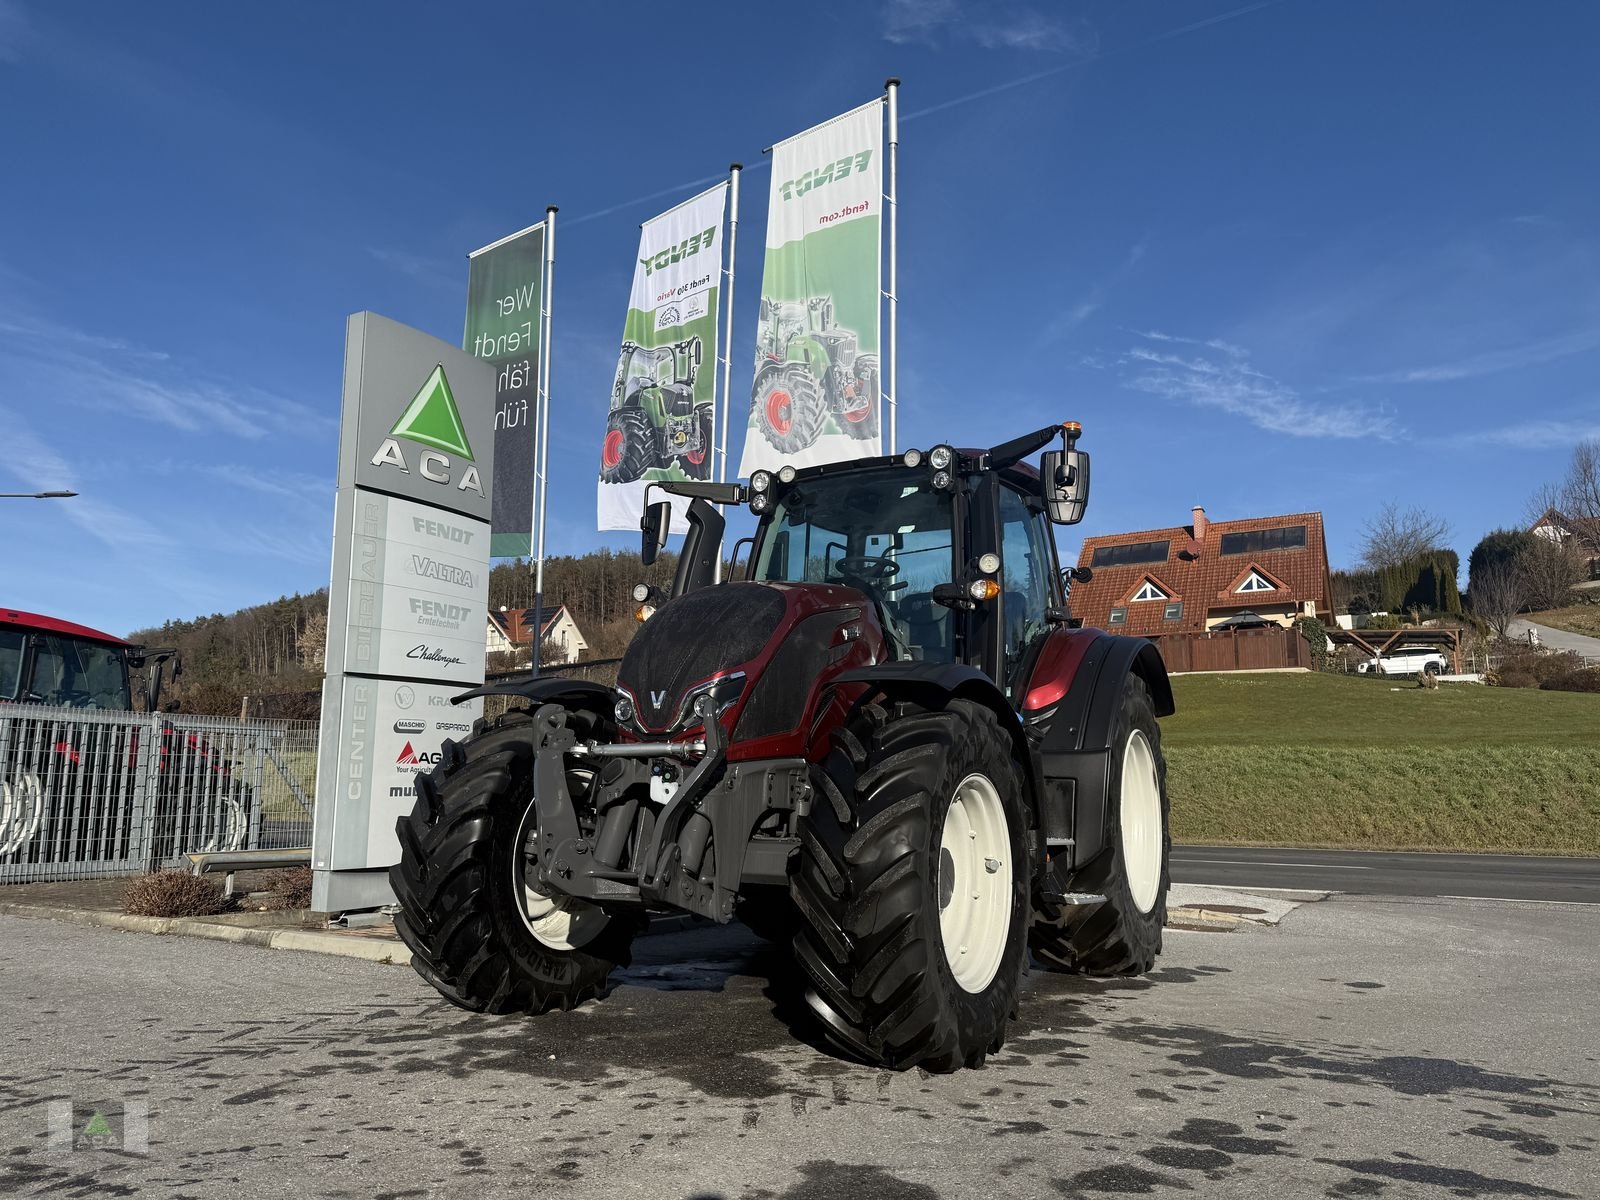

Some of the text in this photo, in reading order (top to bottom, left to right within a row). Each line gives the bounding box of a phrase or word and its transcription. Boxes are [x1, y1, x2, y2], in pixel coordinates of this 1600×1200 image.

[369, 437, 487, 500] ACA
[412, 516, 475, 545] FENDT
[412, 554, 474, 589] VALTRA
[408, 597, 472, 623] FENDT
[417, 615, 461, 630] Erntetechnik
[405, 644, 467, 668] Challenger
[428, 695, 473, 710] KRAER
[398, 721, 426, 729] MASCHIO
[435, 722, 470, 732] GASPARDO
[347, 685, 368, 800] CENTER
[418, 752, 442, 765] AG
[396, 766, 409, 774] Your
